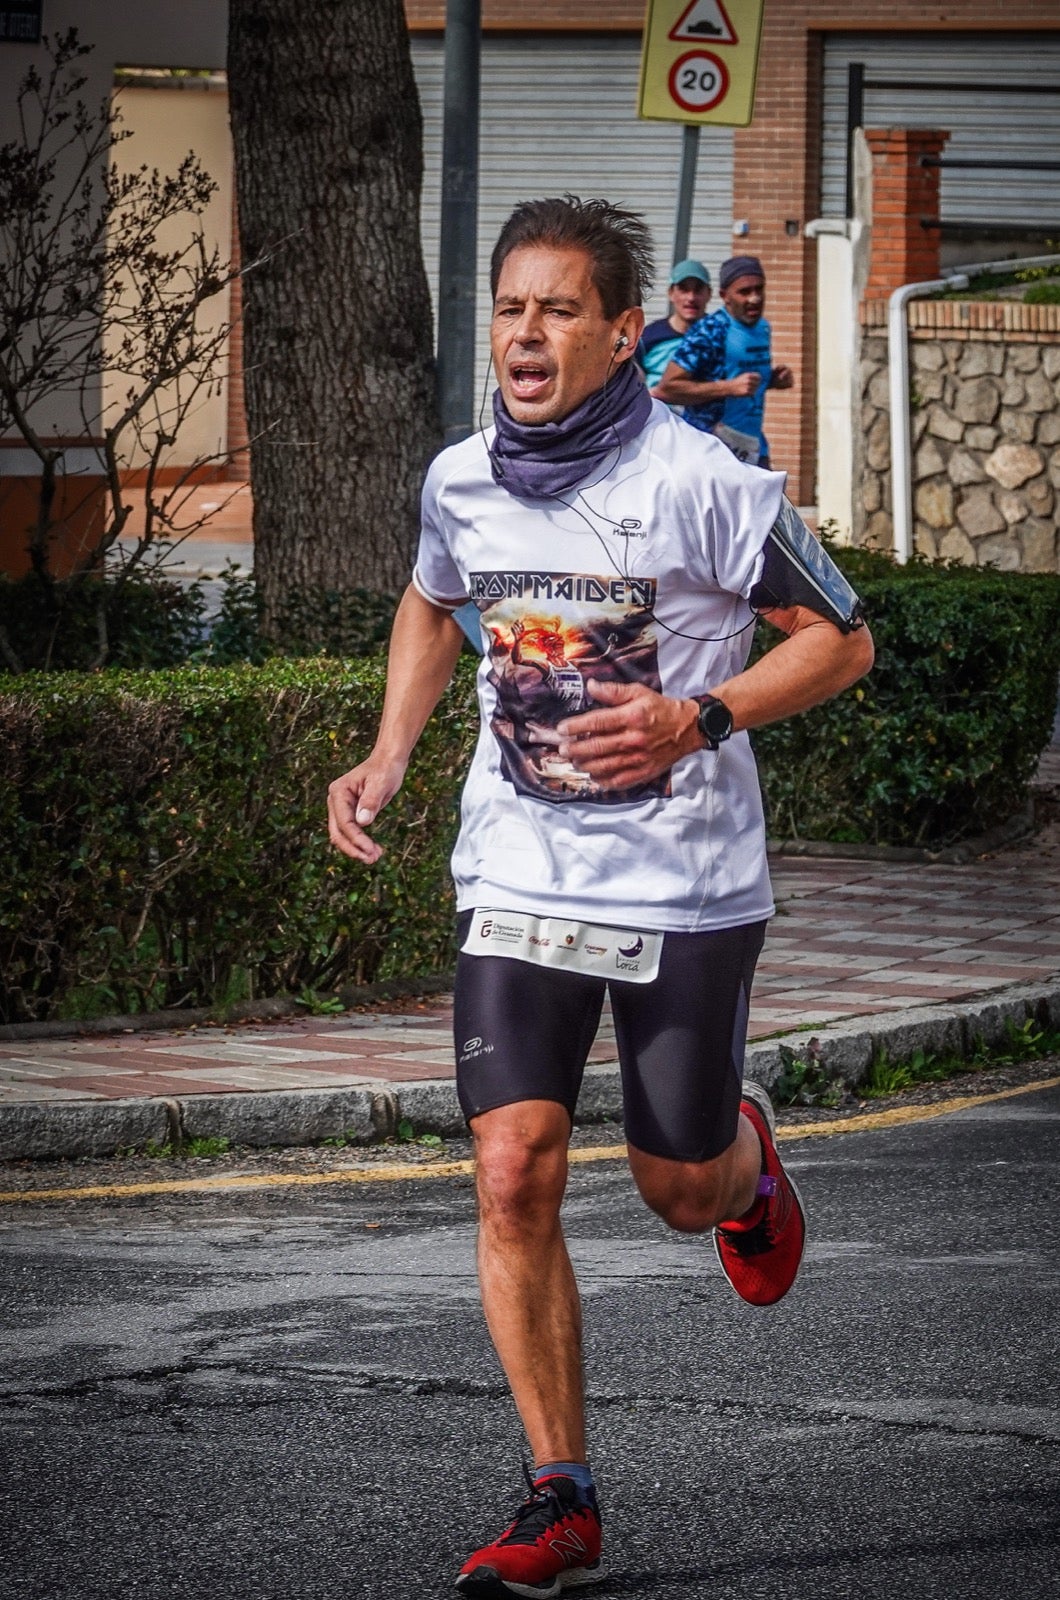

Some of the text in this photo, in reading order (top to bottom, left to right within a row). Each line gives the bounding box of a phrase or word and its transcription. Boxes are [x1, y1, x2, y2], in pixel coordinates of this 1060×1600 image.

[682, 69, 716, 92] 20
[471, 573, 651, 605] IRON MAIDEN
[615, 953, 640, 972] Lorca
